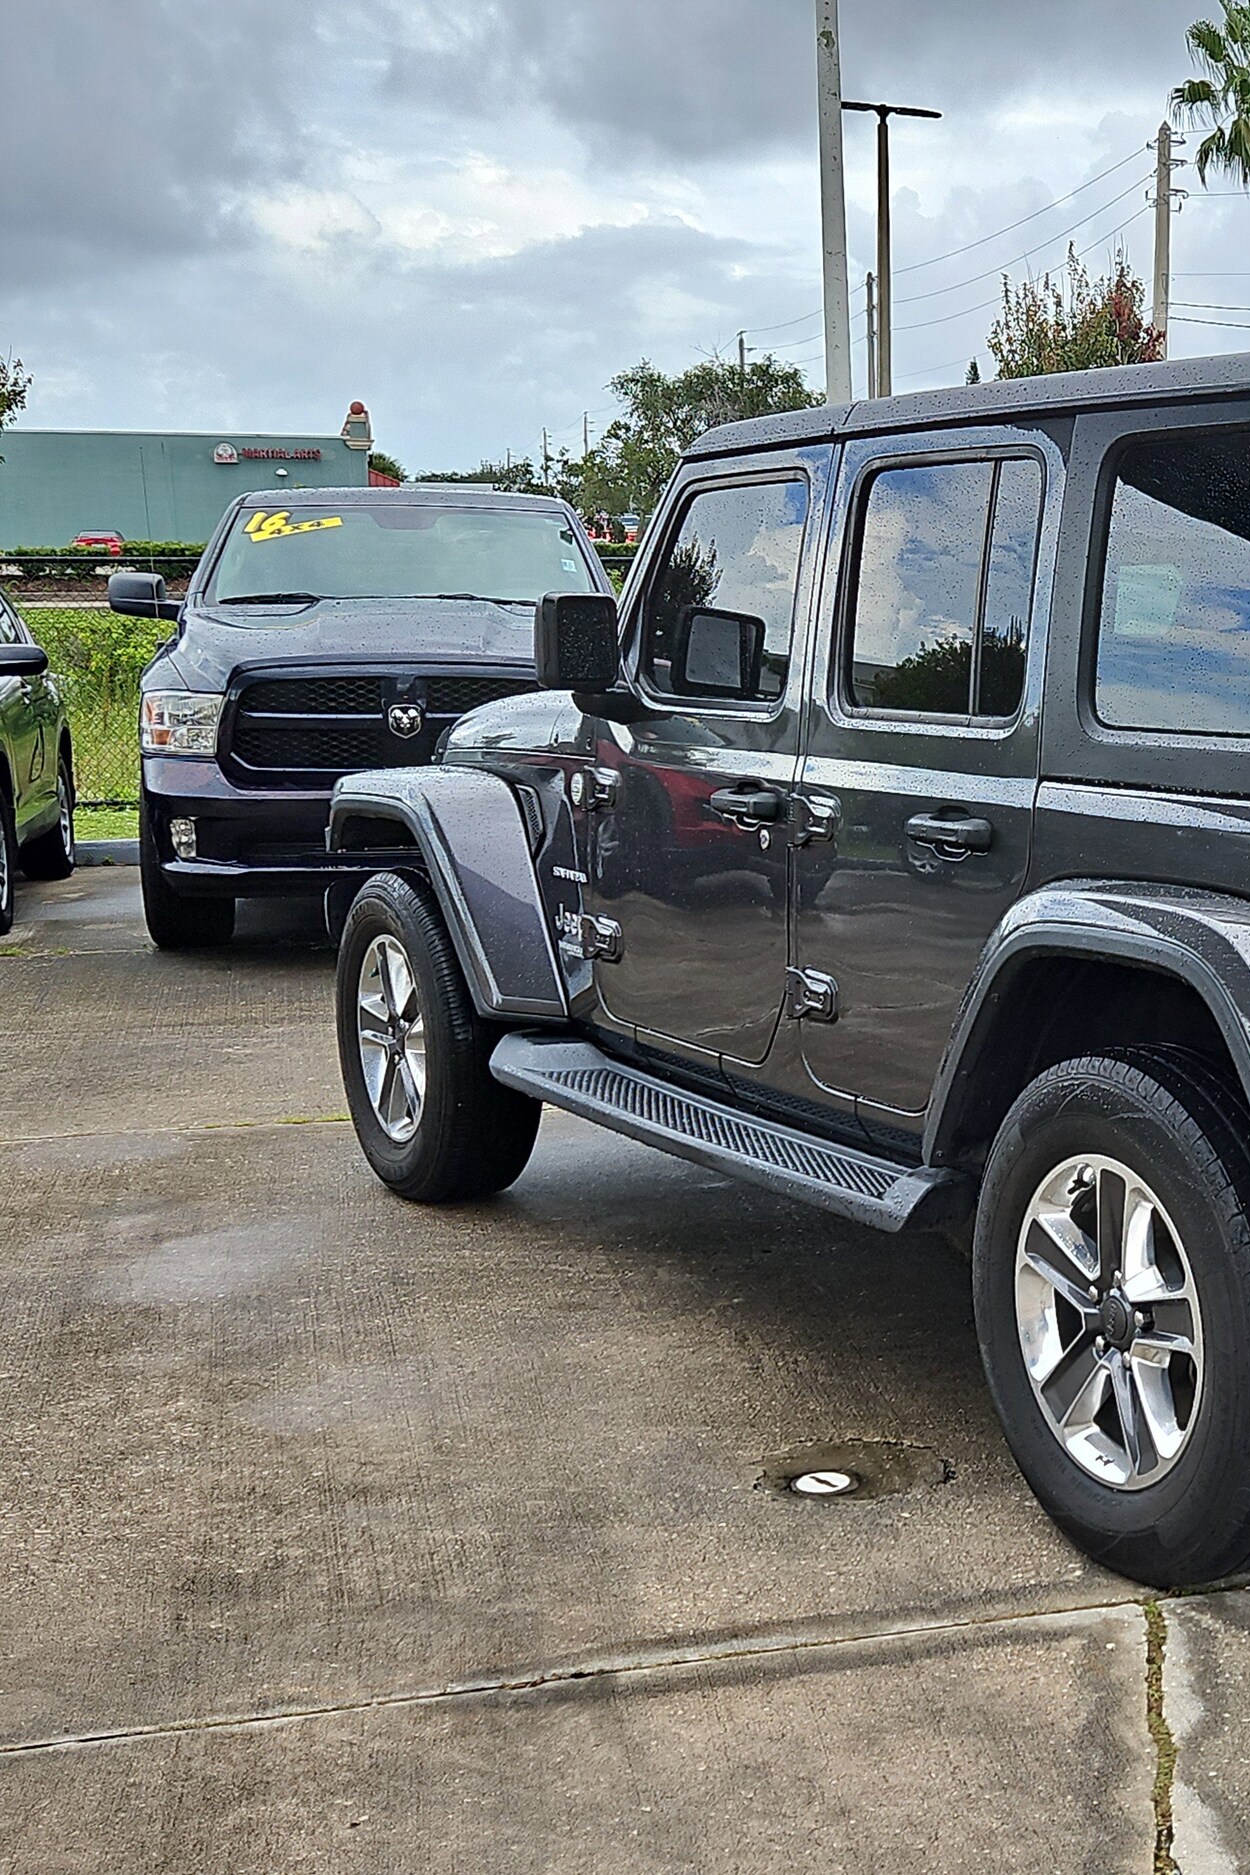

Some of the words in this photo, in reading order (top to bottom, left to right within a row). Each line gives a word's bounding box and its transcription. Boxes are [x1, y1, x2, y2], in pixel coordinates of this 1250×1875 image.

[241, 447, 291, 459] MARTIAL
[293, 448, 322, 460] ARTS
[243, 511, 291, 534] 16
